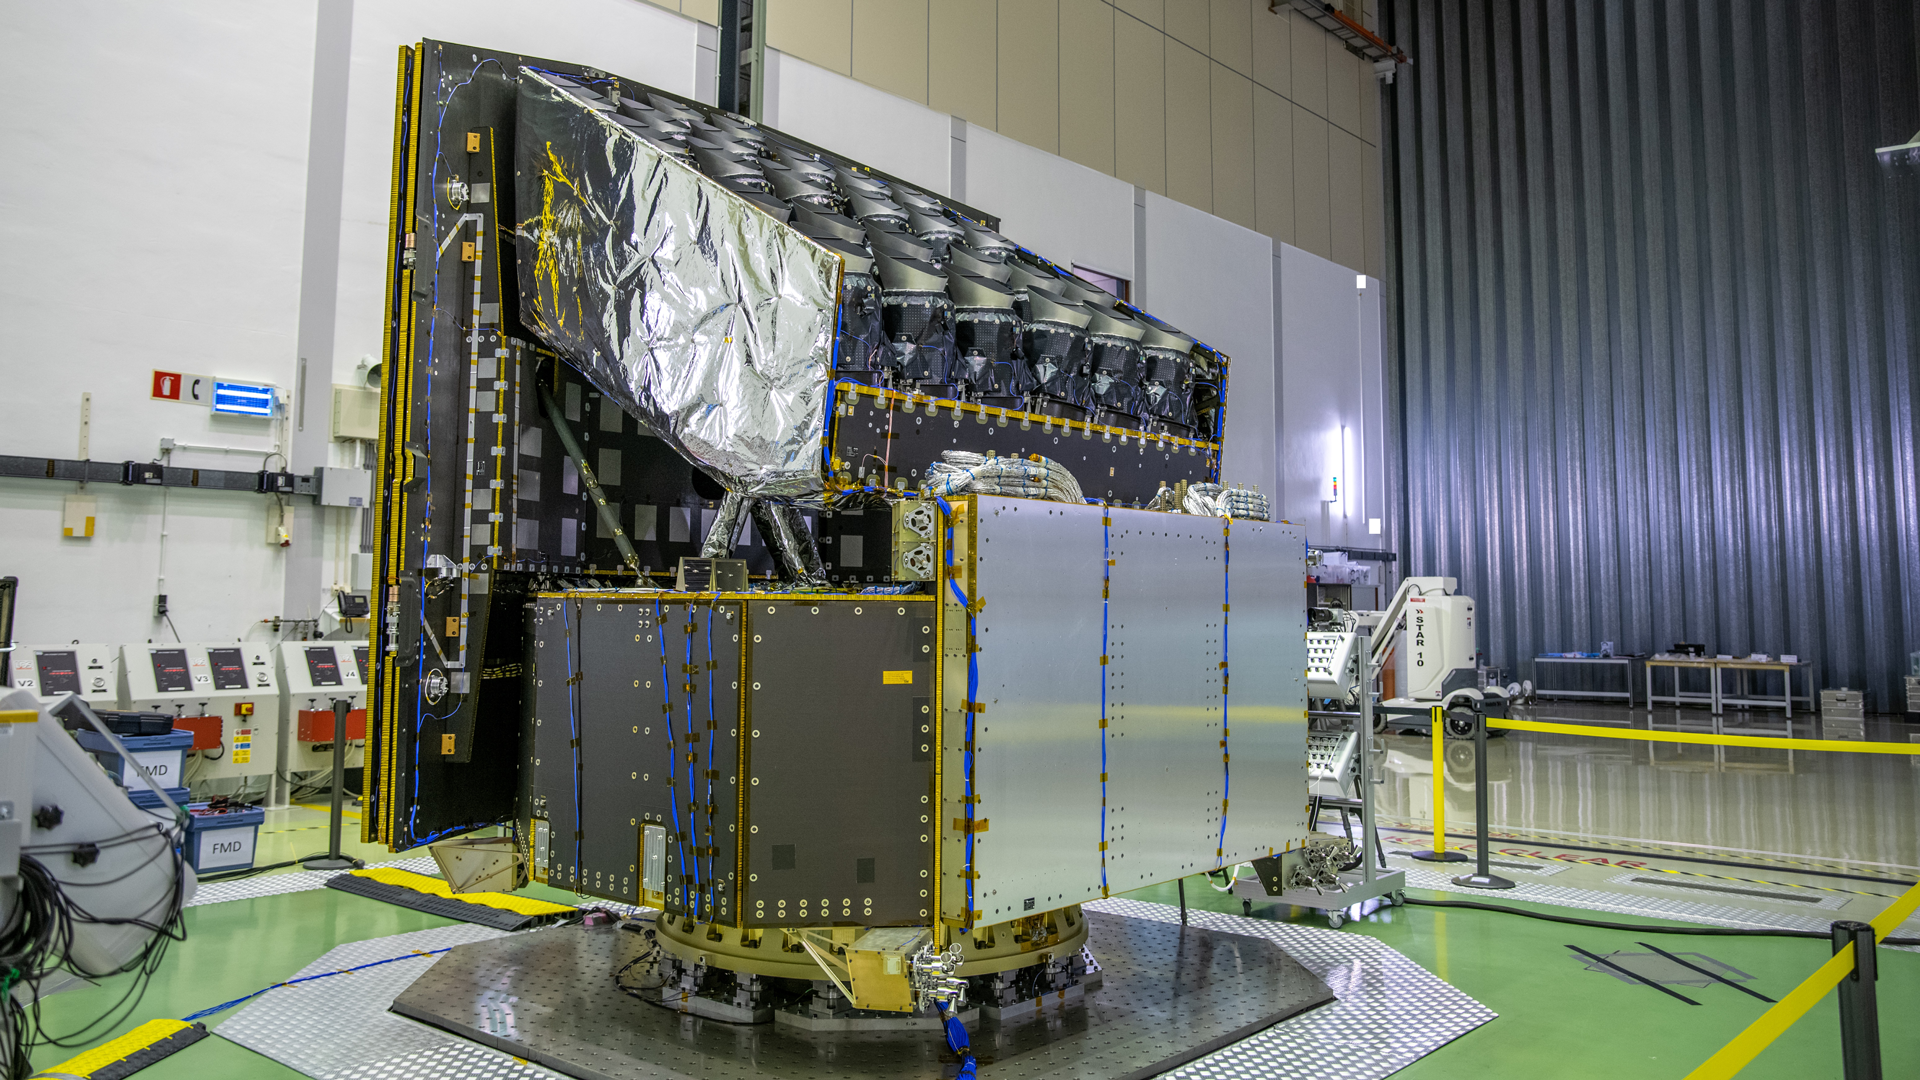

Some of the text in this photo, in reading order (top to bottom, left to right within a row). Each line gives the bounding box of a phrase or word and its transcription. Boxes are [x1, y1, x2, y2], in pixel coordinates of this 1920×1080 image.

[1416, 616, 1424, 667] STAR 10
[212, 840, 242, 855] FMD
[1499, 848, 1648, 868] CLEAR
